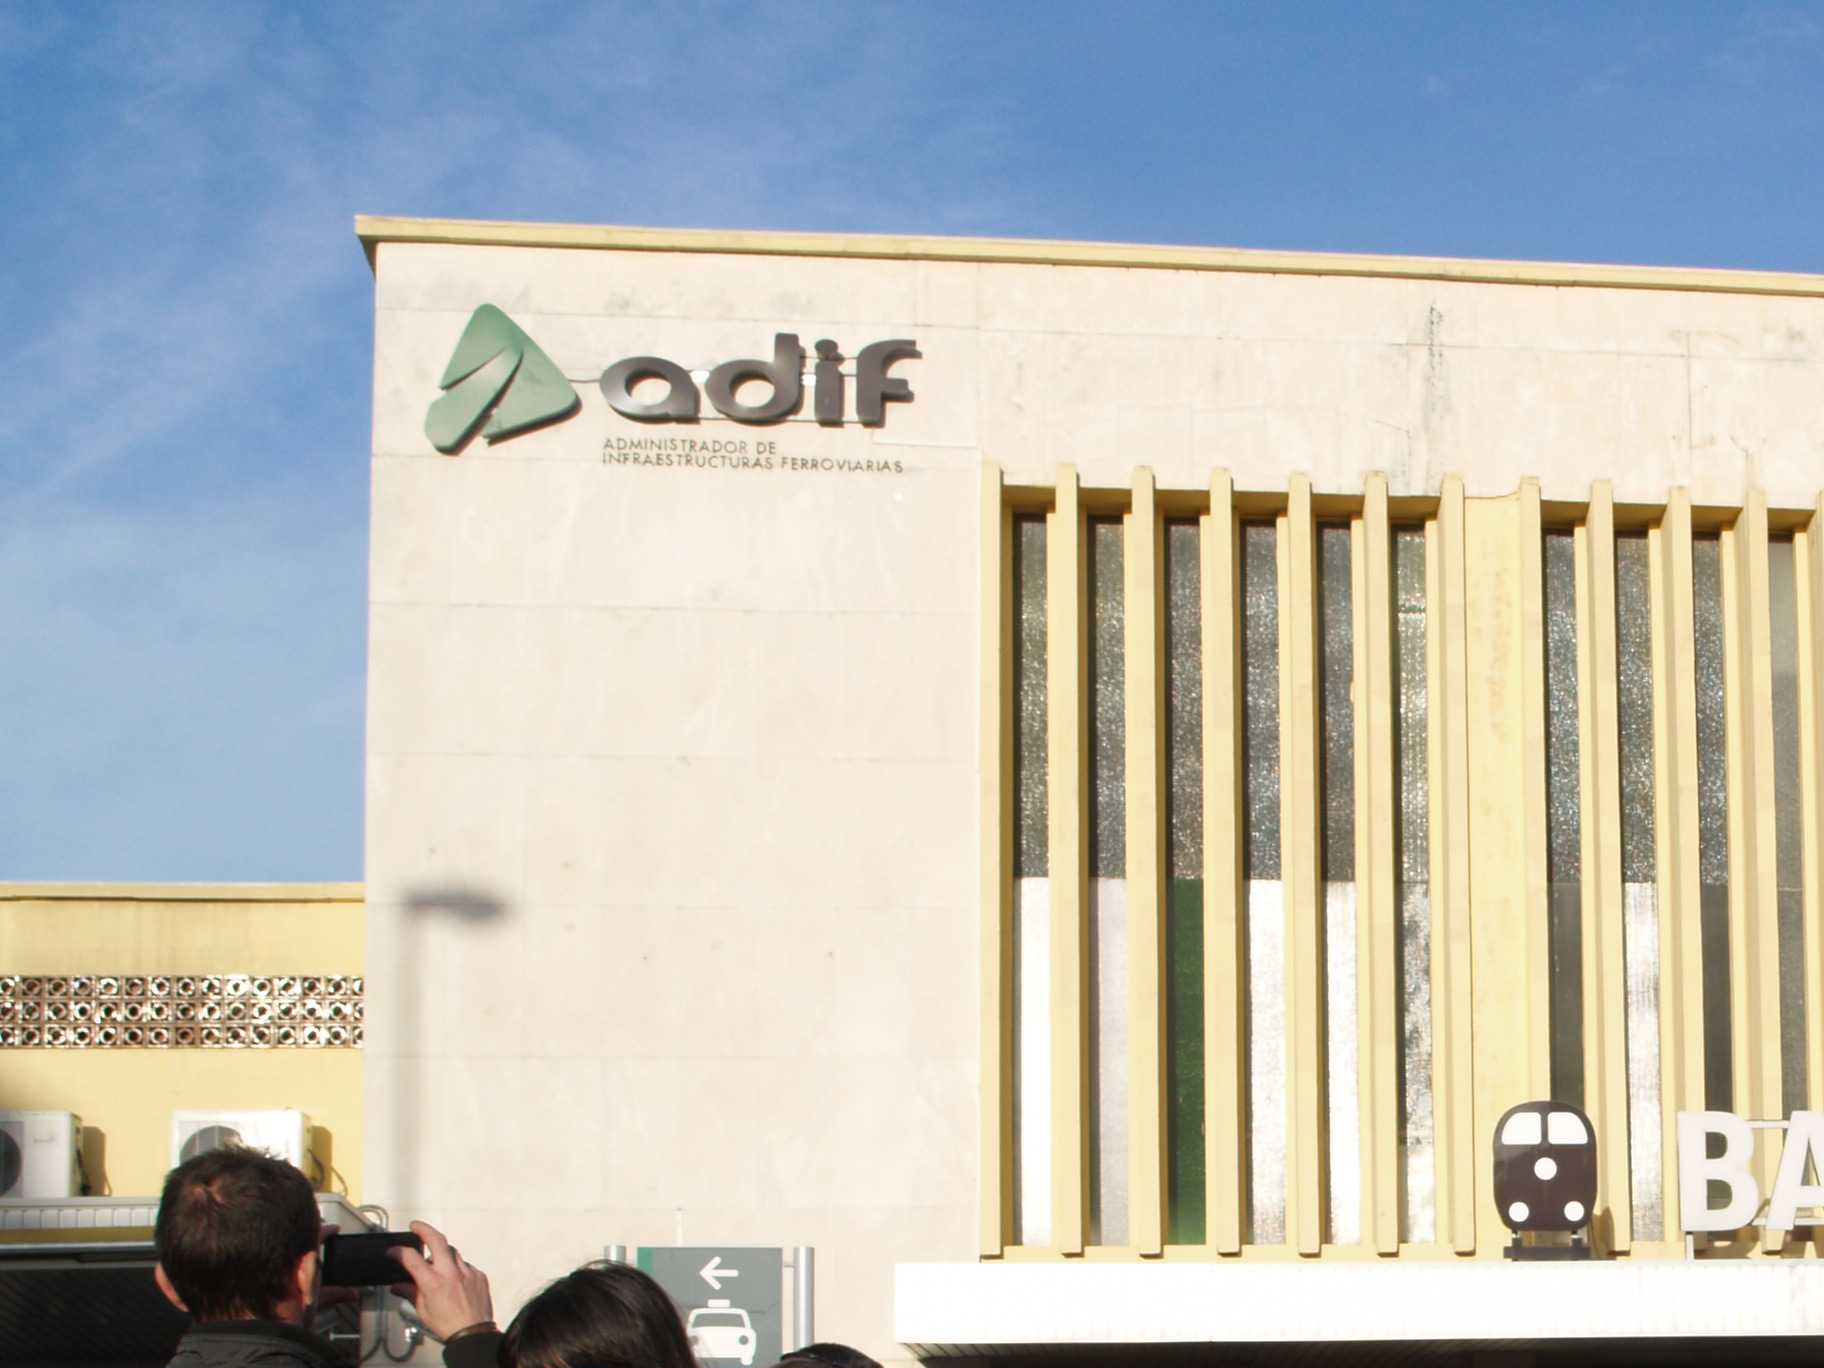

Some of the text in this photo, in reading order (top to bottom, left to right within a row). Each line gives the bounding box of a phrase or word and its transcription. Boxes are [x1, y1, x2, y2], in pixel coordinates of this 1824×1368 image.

[600, 333, 922, 428] adif
[603, 438, 776, 455] ADMINISTRADOR DE
[602, 452, 904, 473] INFRAESTRUCTURAS FERROVIARIAS
